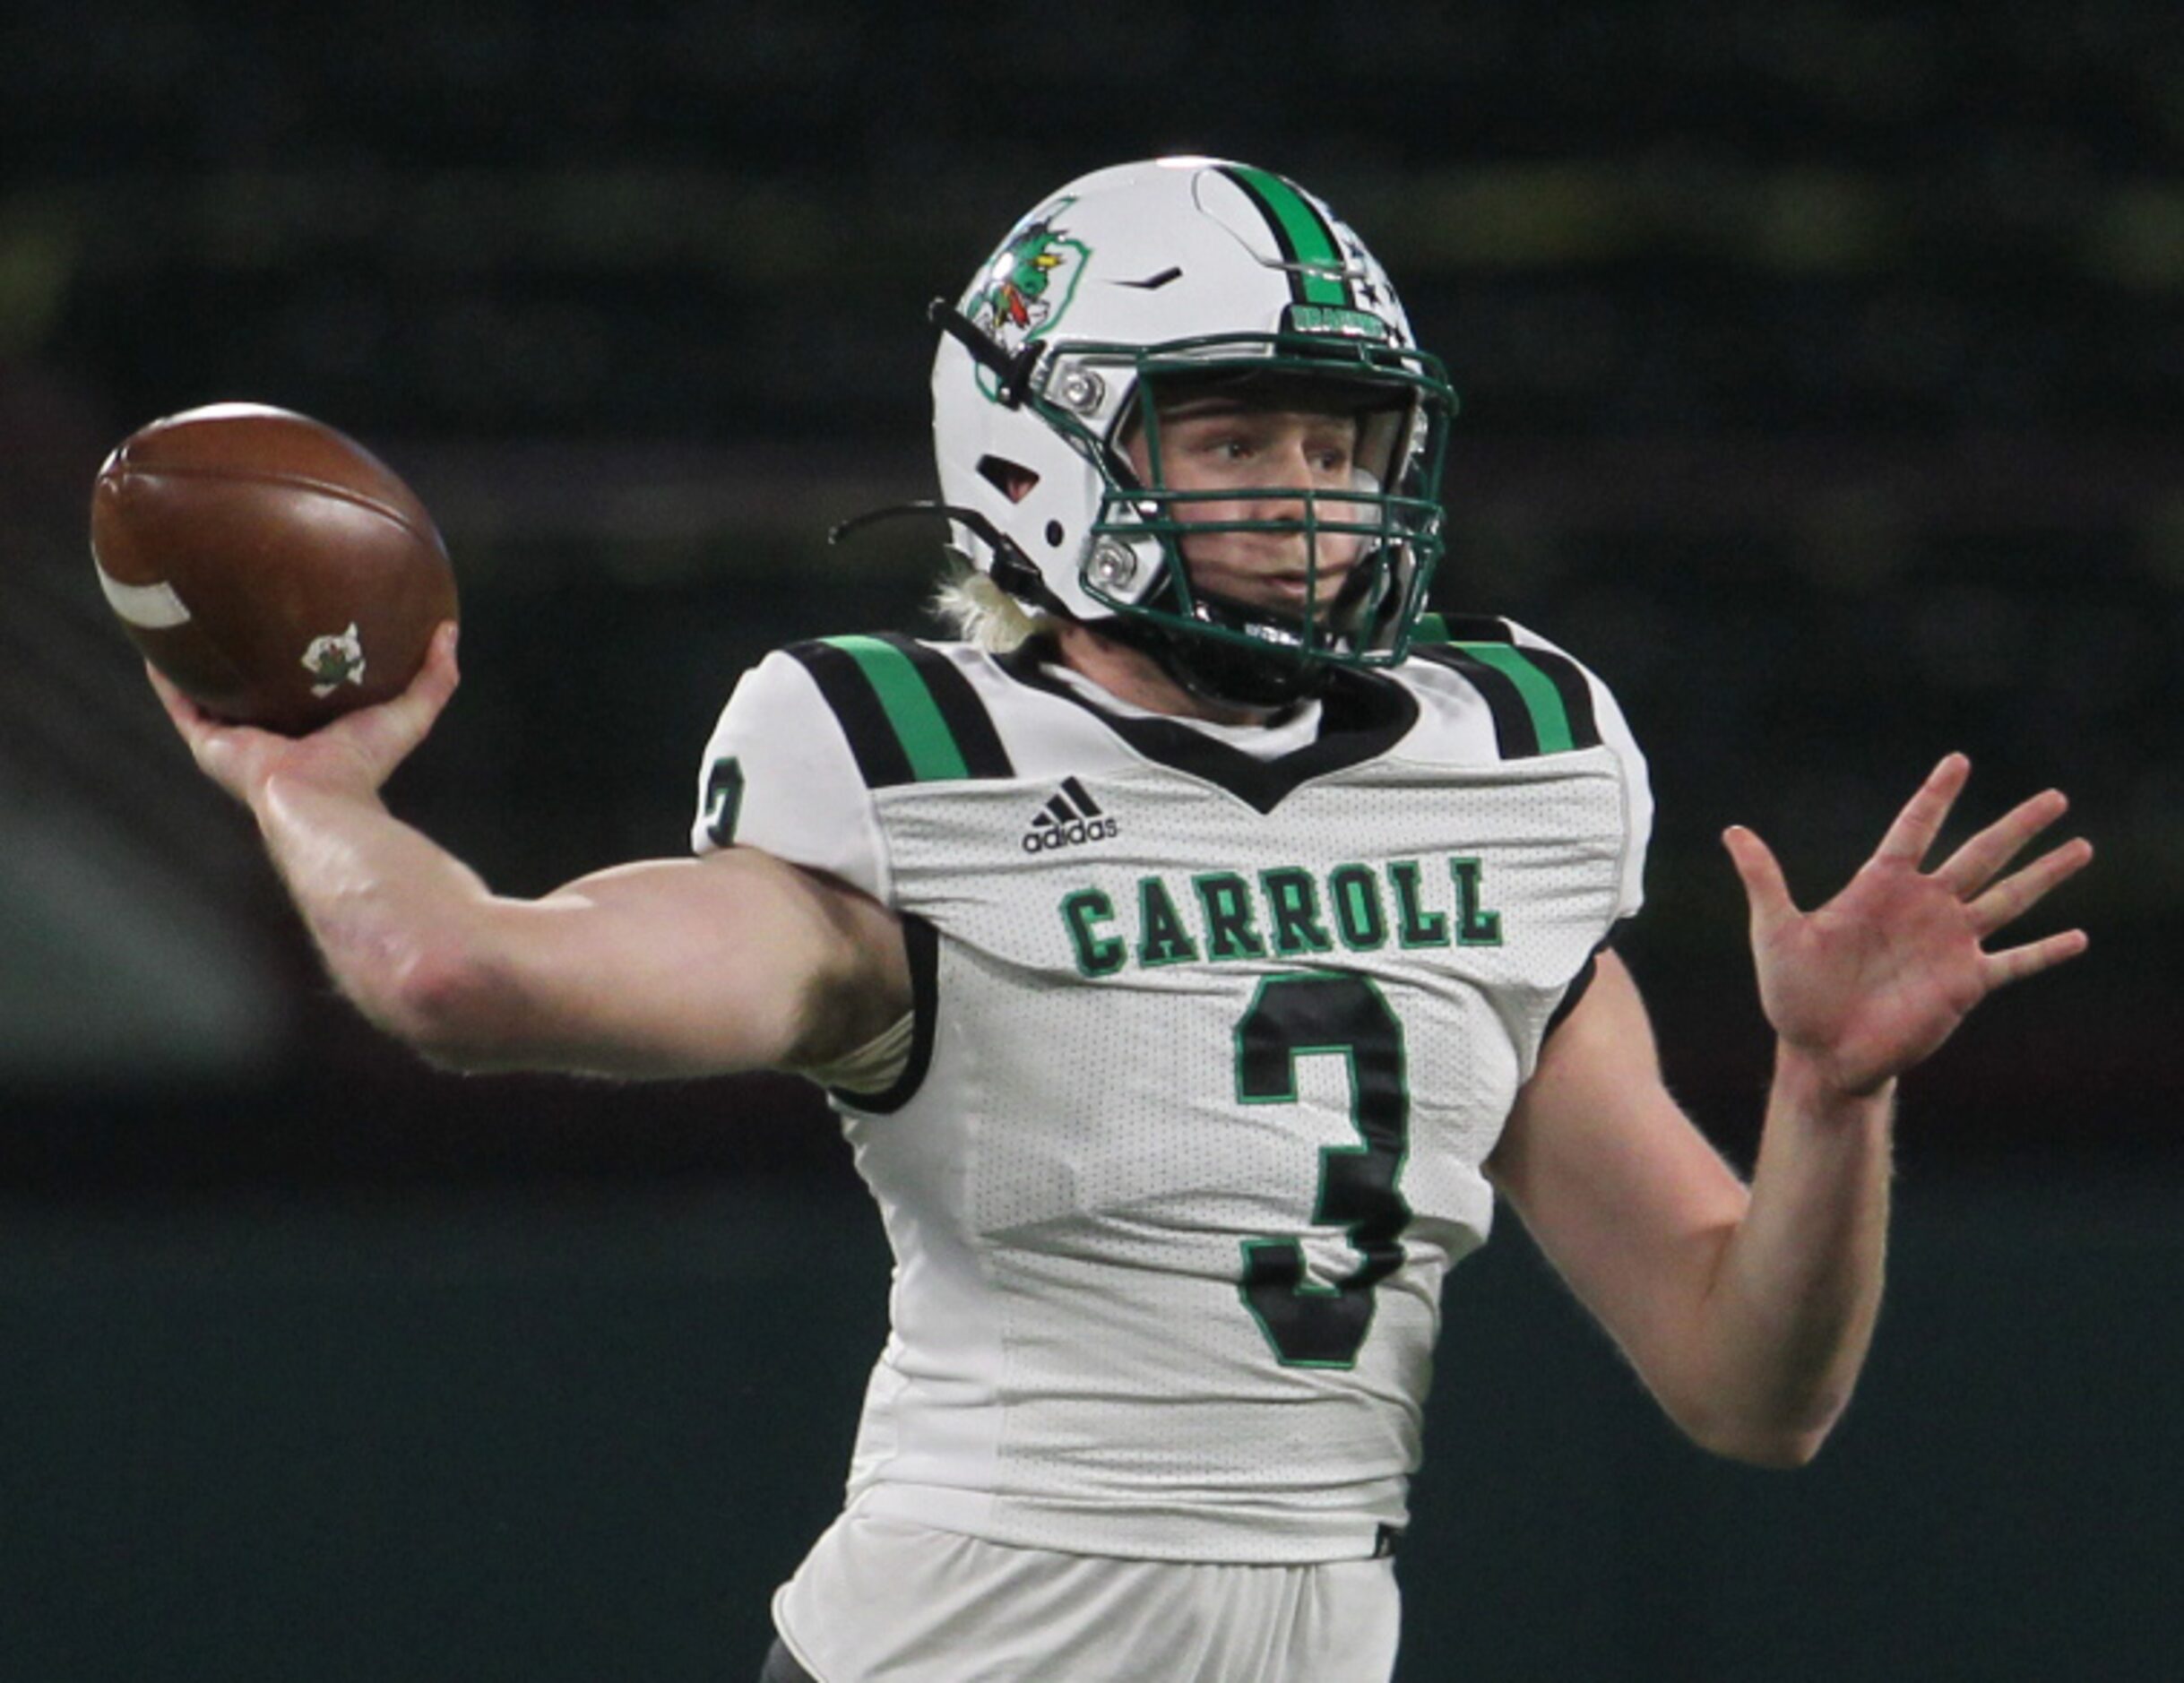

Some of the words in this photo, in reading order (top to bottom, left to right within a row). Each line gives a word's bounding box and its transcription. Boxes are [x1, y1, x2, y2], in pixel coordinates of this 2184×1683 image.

[1023, 817, 1118, 853] adidas
[1059, 857, 1503, 979] CARROLL
[1233, 970, 1413, 1369] 3
